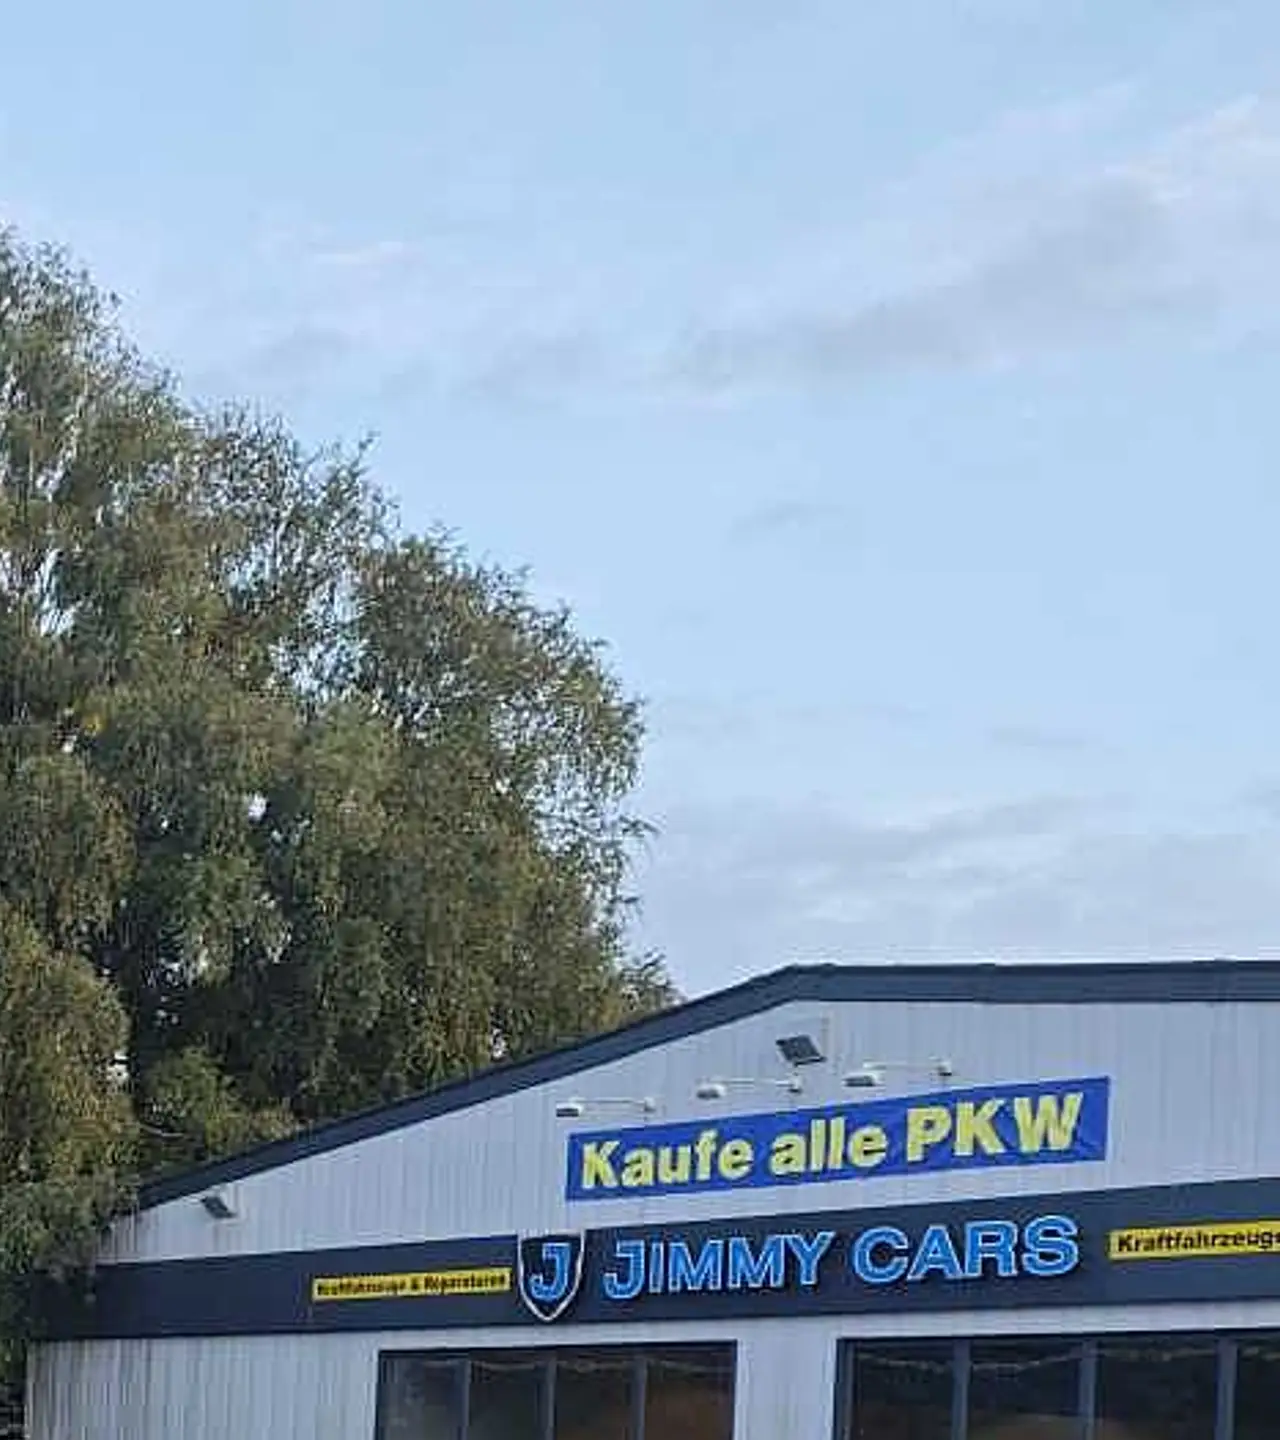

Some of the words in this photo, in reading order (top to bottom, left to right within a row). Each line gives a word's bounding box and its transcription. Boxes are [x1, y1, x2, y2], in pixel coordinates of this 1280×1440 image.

[582, 1131, 754, 1189] Kaufe
[769, 1118, 888, 1177] alle
[907, 1091, 1083, 1161] PKW
[528, 1241, 571, 1301] J
[603, 1231, 836, 1300] JIMMY
[852, 1215, 1079, 1284] CARS
